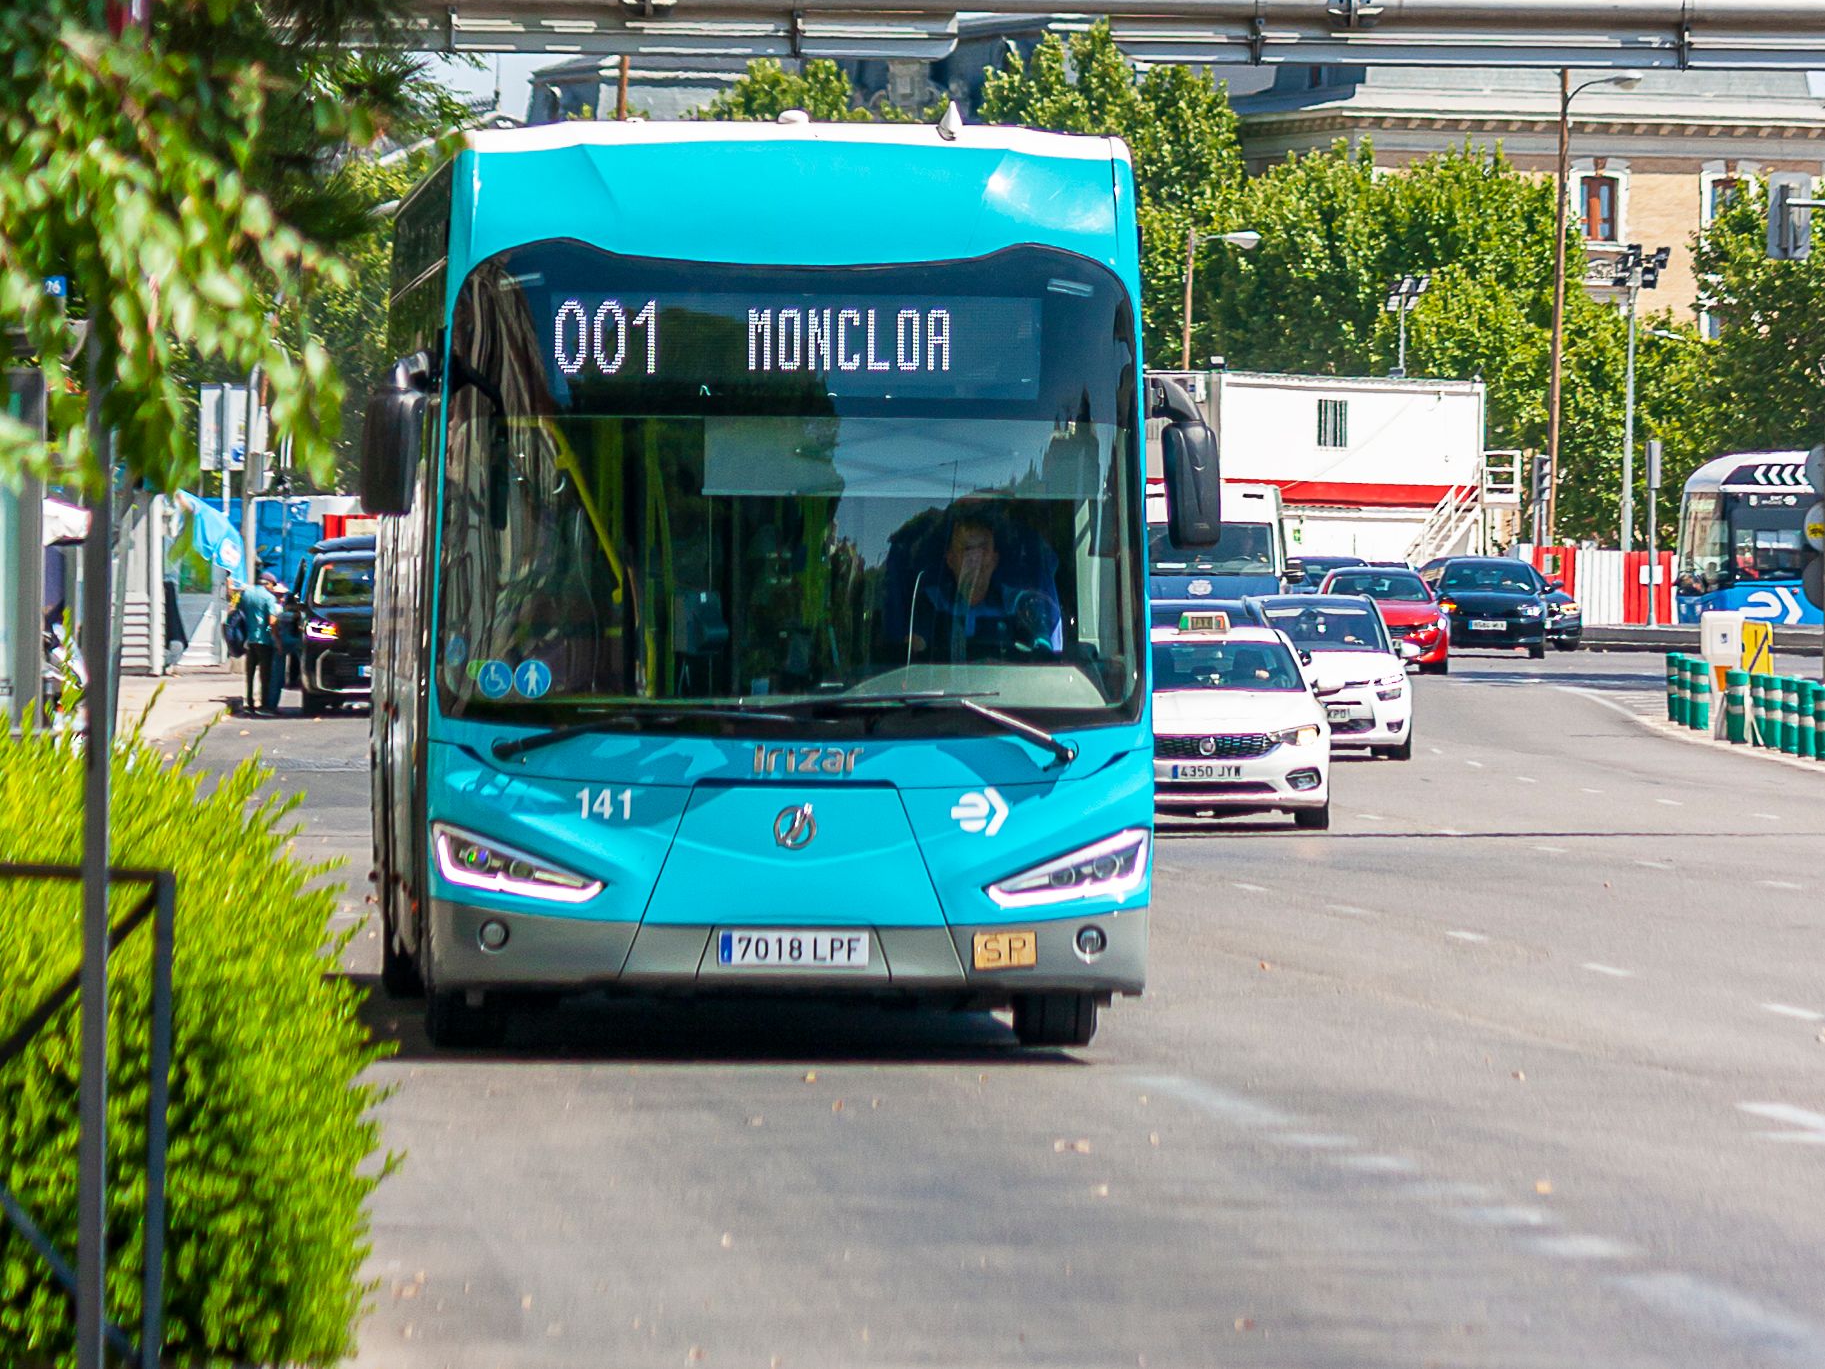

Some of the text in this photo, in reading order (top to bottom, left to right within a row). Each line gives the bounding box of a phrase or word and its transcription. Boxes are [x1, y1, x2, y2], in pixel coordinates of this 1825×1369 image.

[554, 299, 951, 375] 001 MONCLOA
[1180, 765, 1241, 778] 4350 JYW
[576, 787, 632, 820] 141
[737, 937, 861, 961] 7018 LPF
[984, 936, 1027, 963] SP
